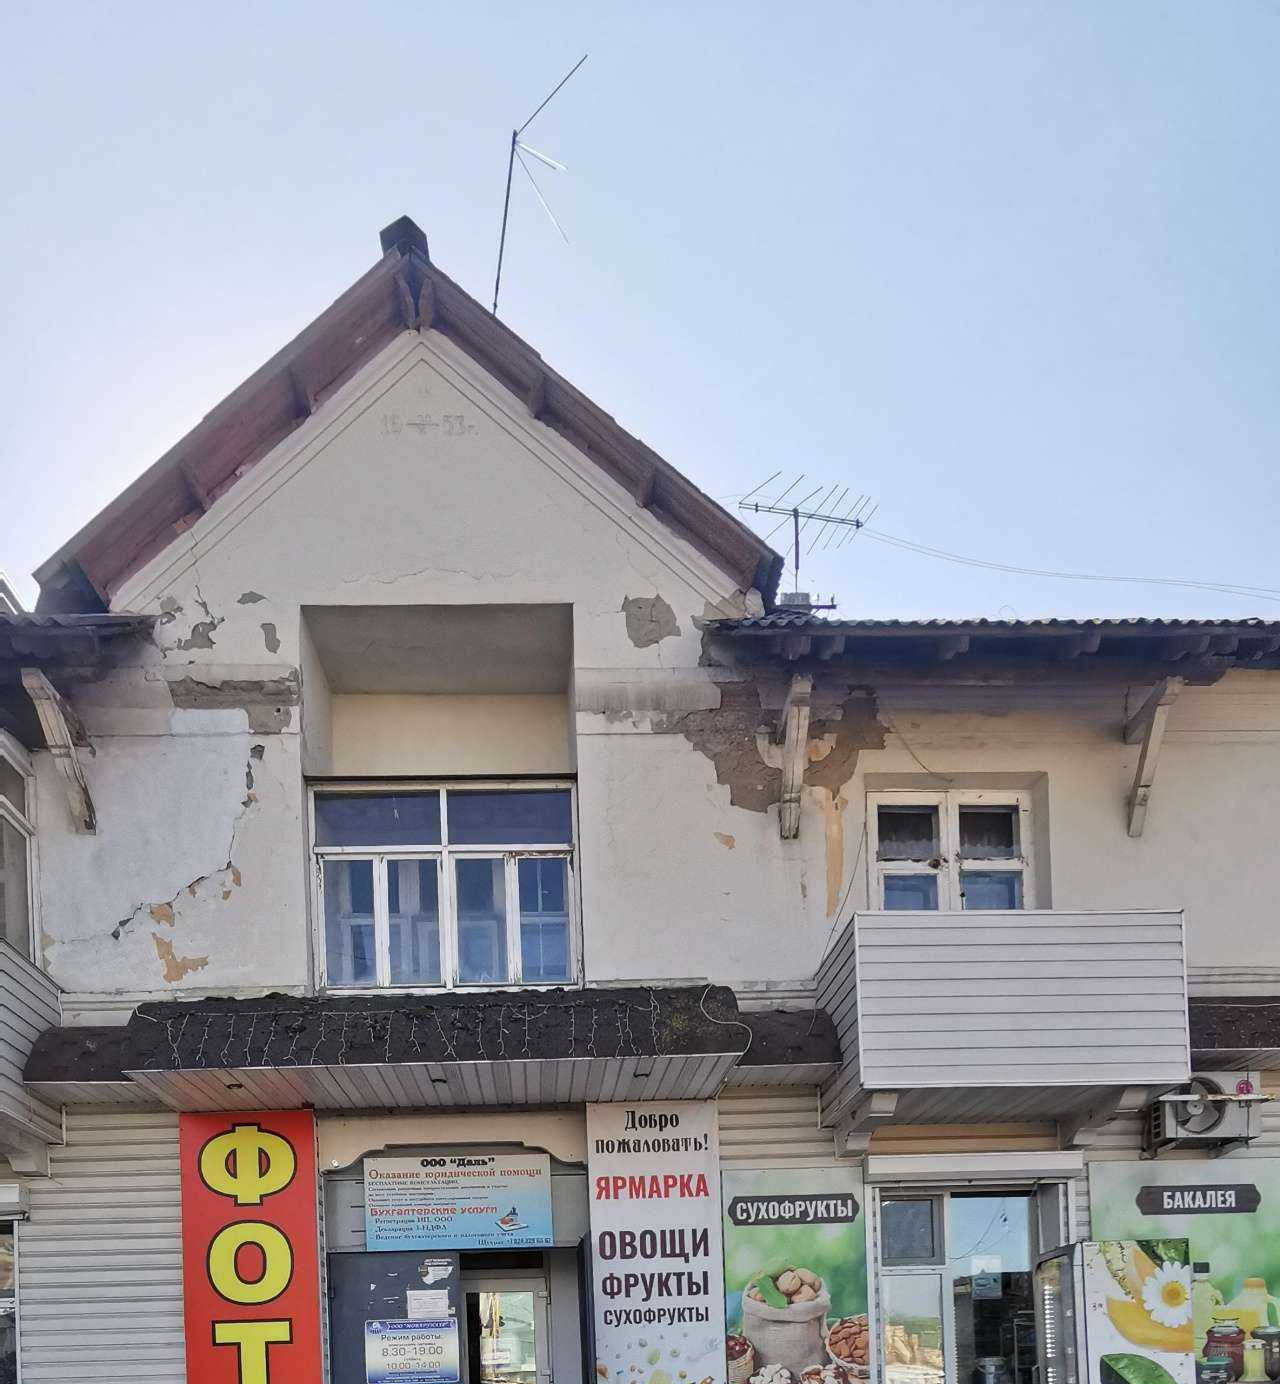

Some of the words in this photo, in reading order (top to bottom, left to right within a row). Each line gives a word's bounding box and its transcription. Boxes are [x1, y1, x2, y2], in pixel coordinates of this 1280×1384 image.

[624, 1110, 679, 1132] Добро
[595, 1133, 709, 1154] пожаловать!
[421, 1159, 447, 1167] ООО
[369, 1169, 420, 1179] Оказание
[425, 1168, 496, 1180] юридической
[500, 1168, 542, 1177] помощи
[595, 1173, 710, 1200] ЯРМАРКА
[735, 1198, 853, 1222] СУХОФРУКТЫ
[1162, 1190, 1237, 1210] БАКАЛЕЯ
[371, 1207, 457, 1216] Бухгалтерские
[460, 1206, 497, 1214] услуги
[599, 1228, 710, 1263] ОВОЩИ
[602, 1270, 709, 1302] ФРУКТЫ
[604, 1306, 709, 1327] СУХОФРУКТЫ
